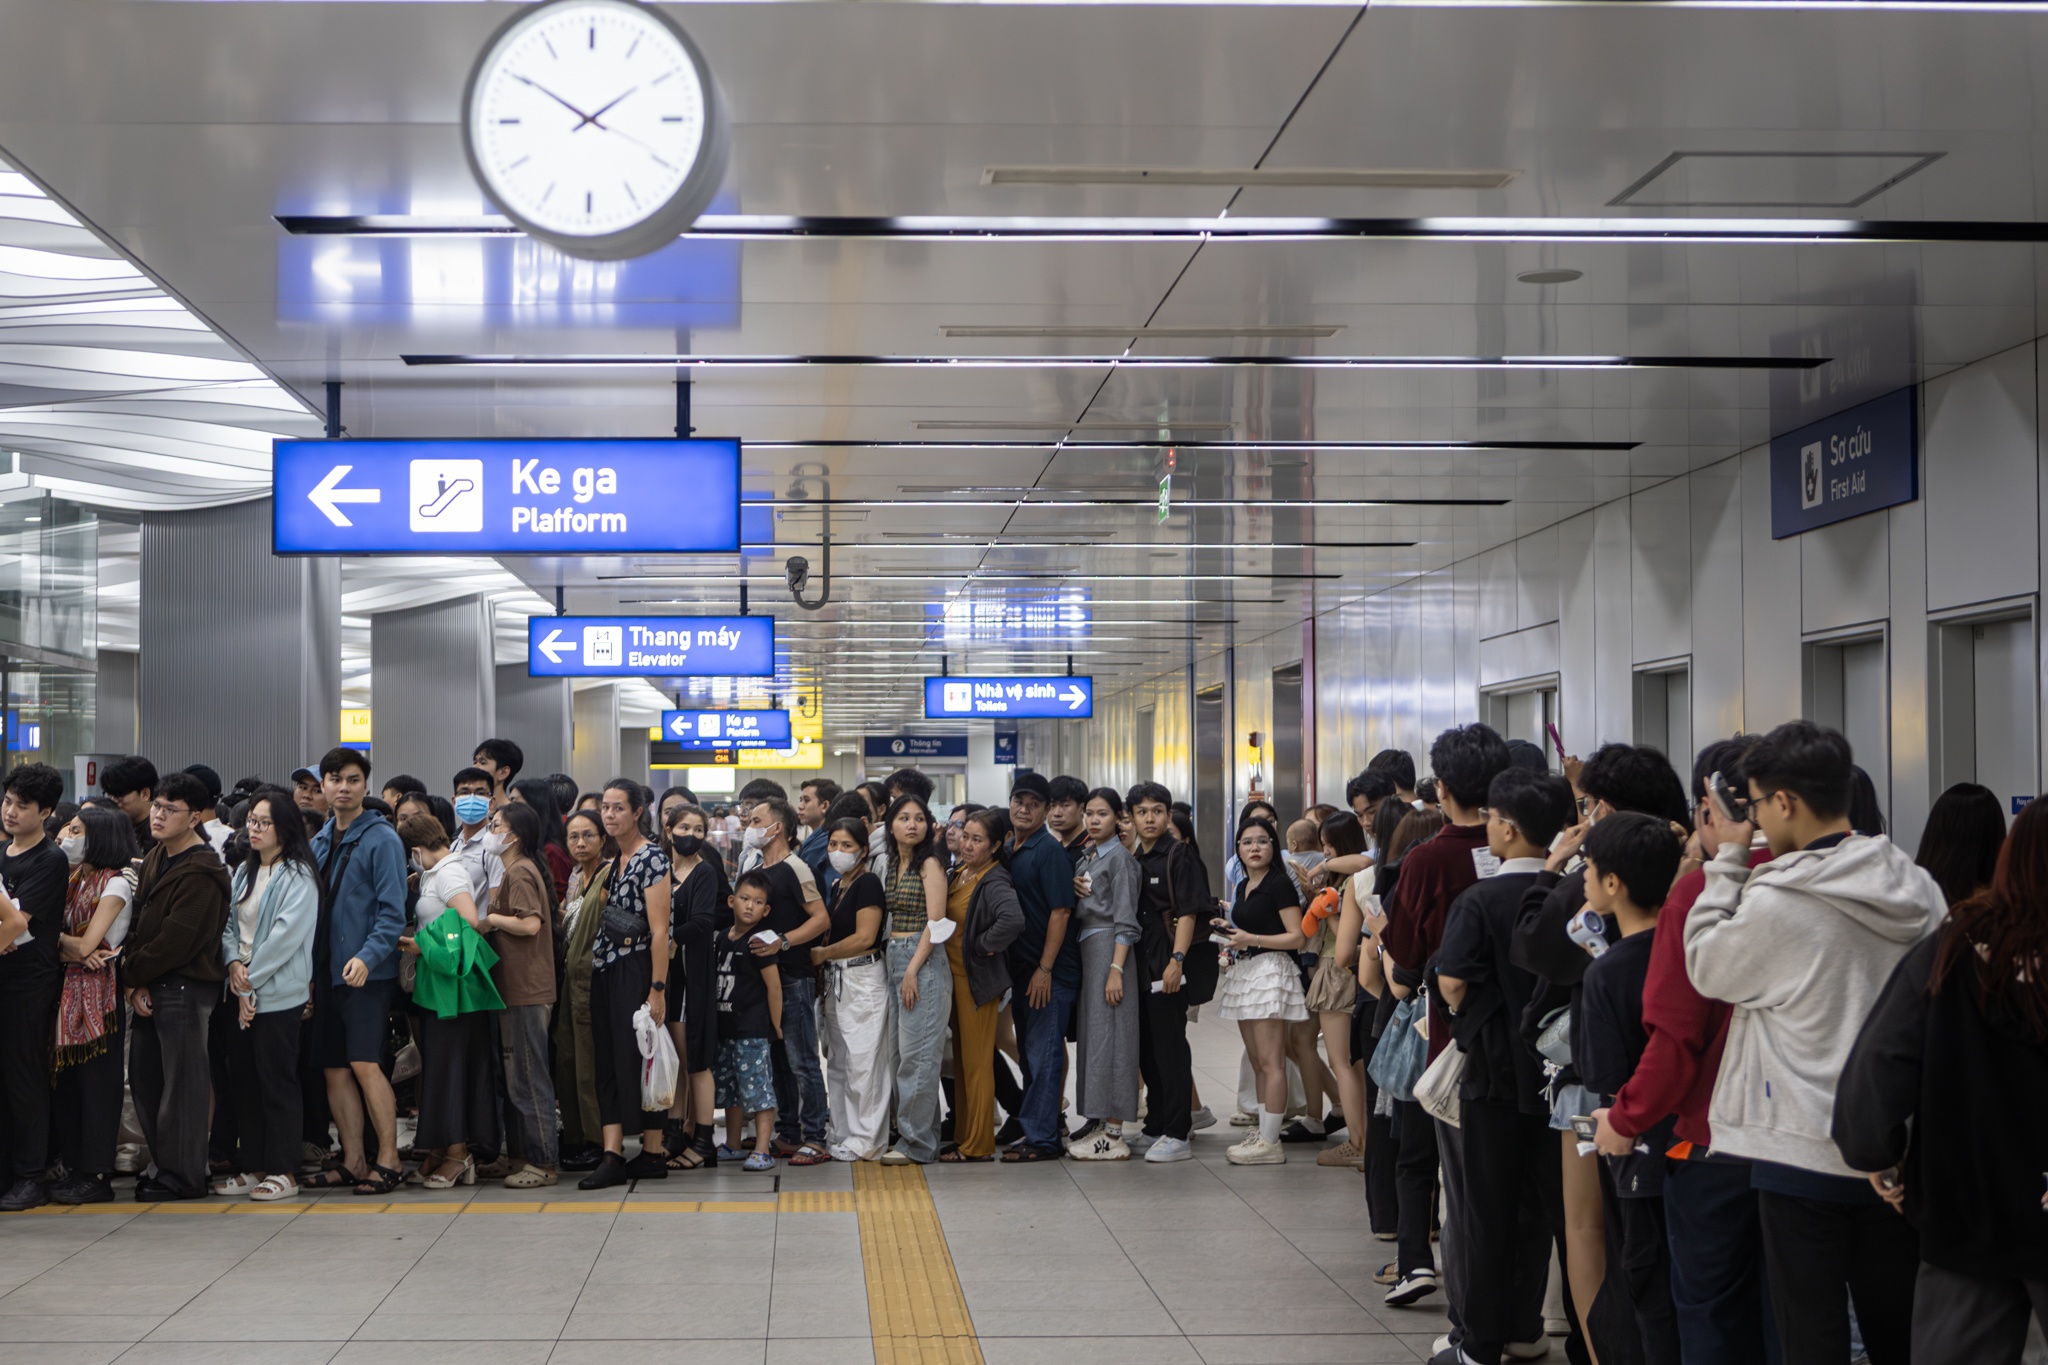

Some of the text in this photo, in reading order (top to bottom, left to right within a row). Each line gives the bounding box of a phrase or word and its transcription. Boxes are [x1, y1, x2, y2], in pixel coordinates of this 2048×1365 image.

[1830, 424, 1871, 466] Sơ cứu
[512, 458, 617, 503] Ke ga
[1830, 469, 1866, 501] First Aid
[512, 506, 627, 533] Platform
[628, 625, 741, 651] Thang máy
[628, 651, 687, 667] Elevator
[974, 682, 1056, 701] Nhà vệ sinh
[975, 700, 1008, 712] Toilets
[726, 714, 757, 728] Ke ga
